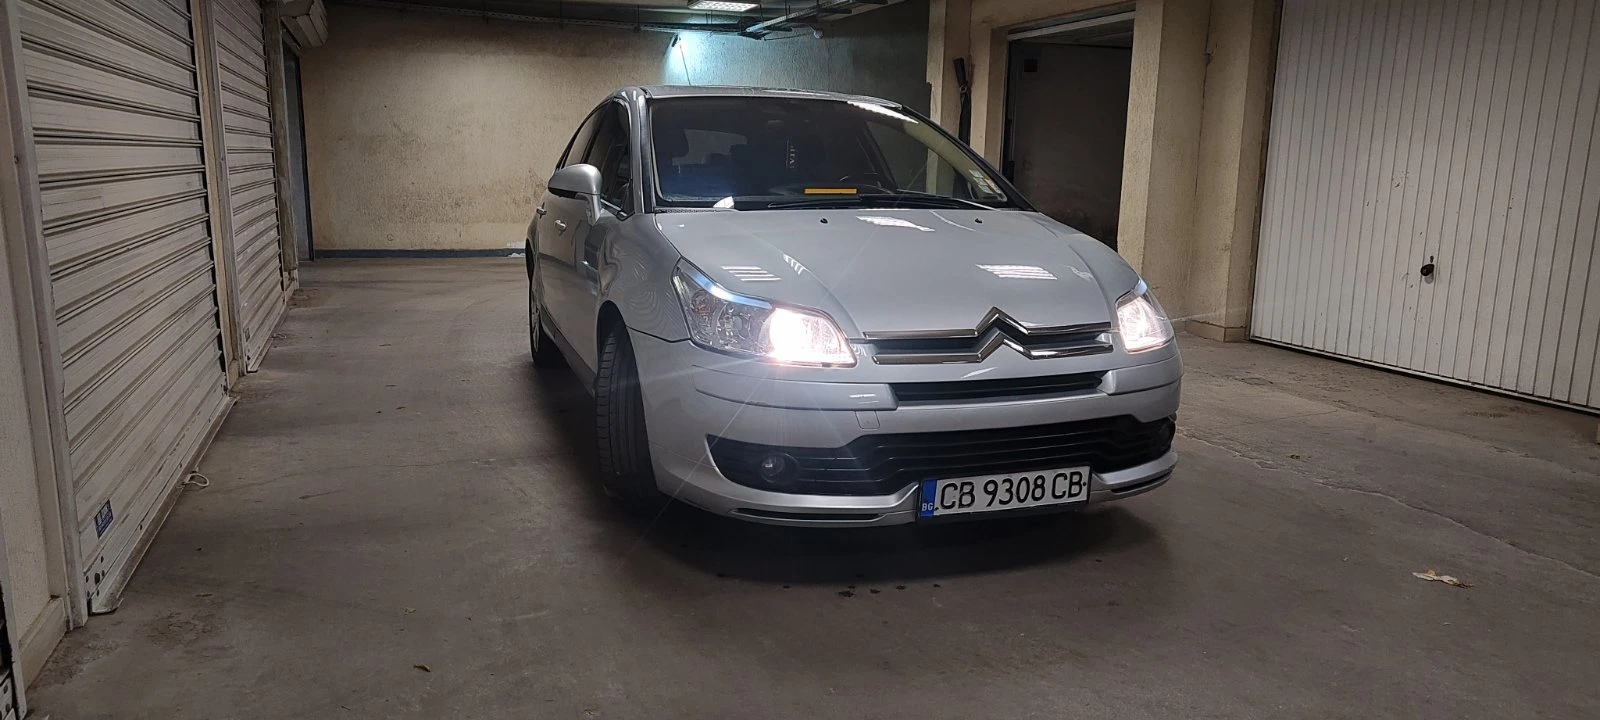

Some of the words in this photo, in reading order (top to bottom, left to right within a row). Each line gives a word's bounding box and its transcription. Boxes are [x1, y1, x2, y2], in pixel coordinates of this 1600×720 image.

[940, 481, 976, 510] CB
[983, 474, 1046, 507] 9308
[1051, 471, 1083, 500] CB
[921, 502, 934, 512] BG
